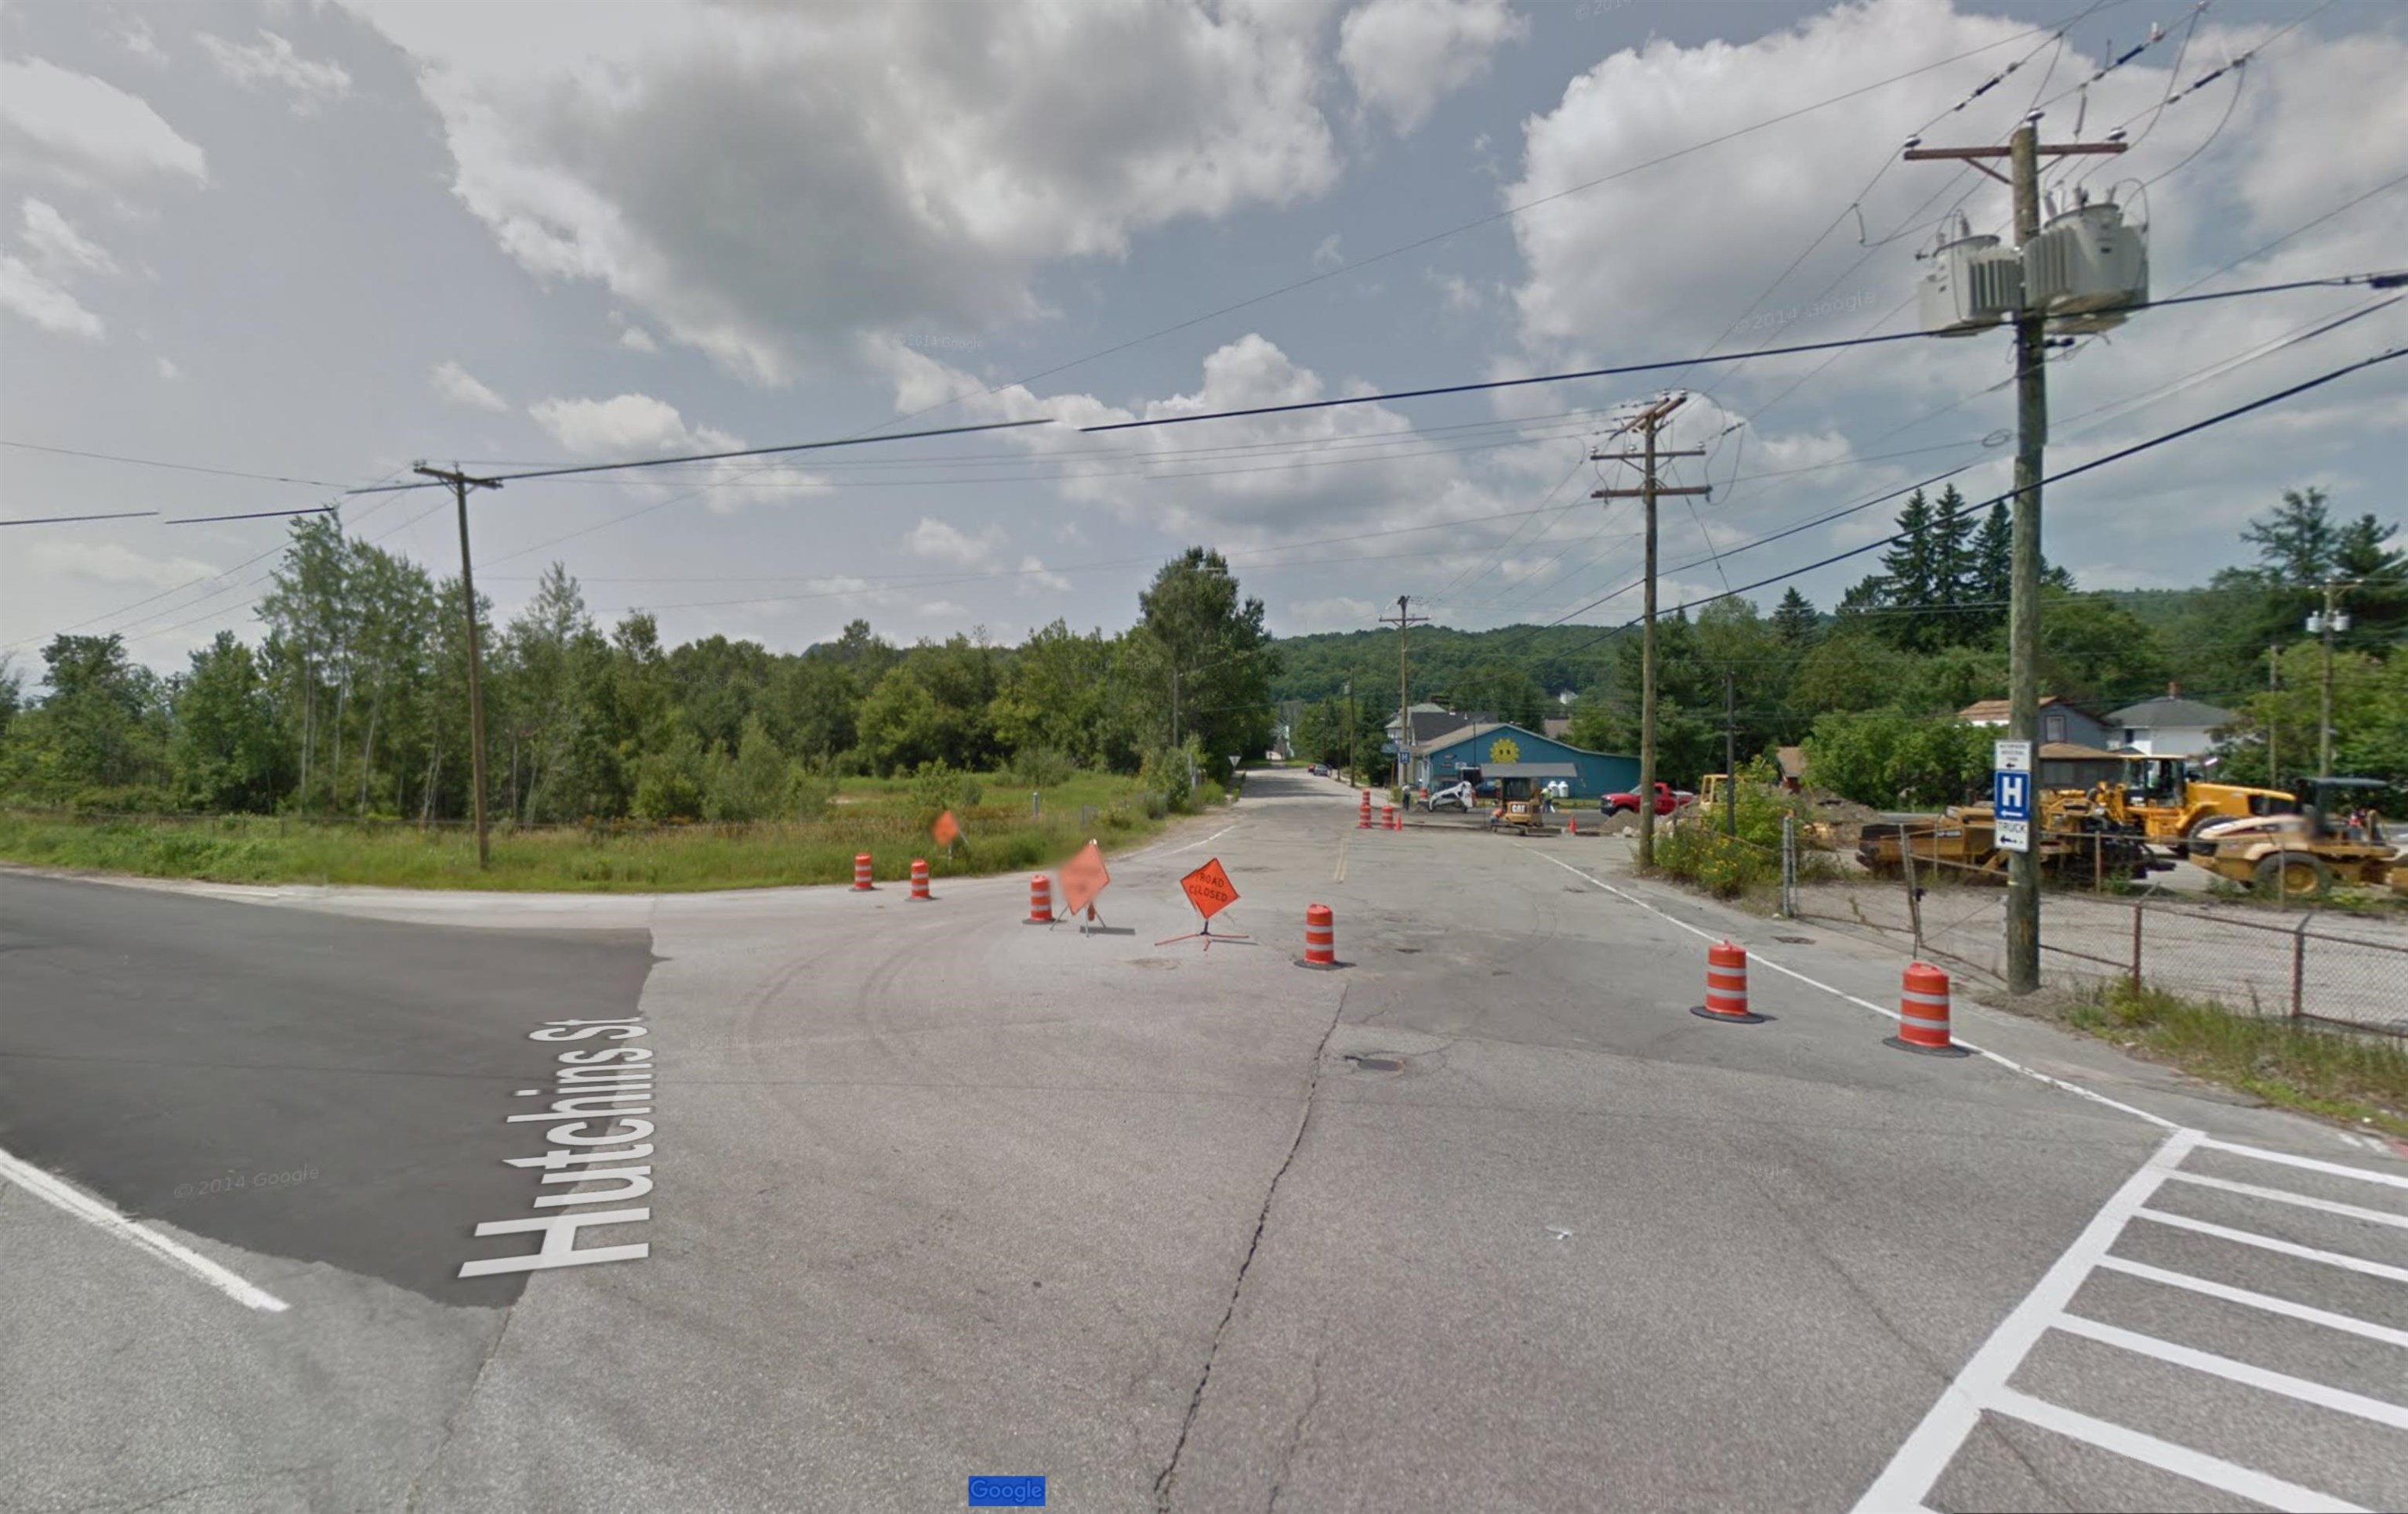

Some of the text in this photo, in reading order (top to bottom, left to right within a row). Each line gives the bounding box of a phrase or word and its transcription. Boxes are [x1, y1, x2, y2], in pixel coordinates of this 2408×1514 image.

[2002, 777, 2022, 808] H
[1511, 804, 1526, 813] CAT
[1998, 821, 2026, 833] TRUCK
[1195, 872, 1224, 888] ROAD
[1188, 885, 1228, 902] CLOSED
